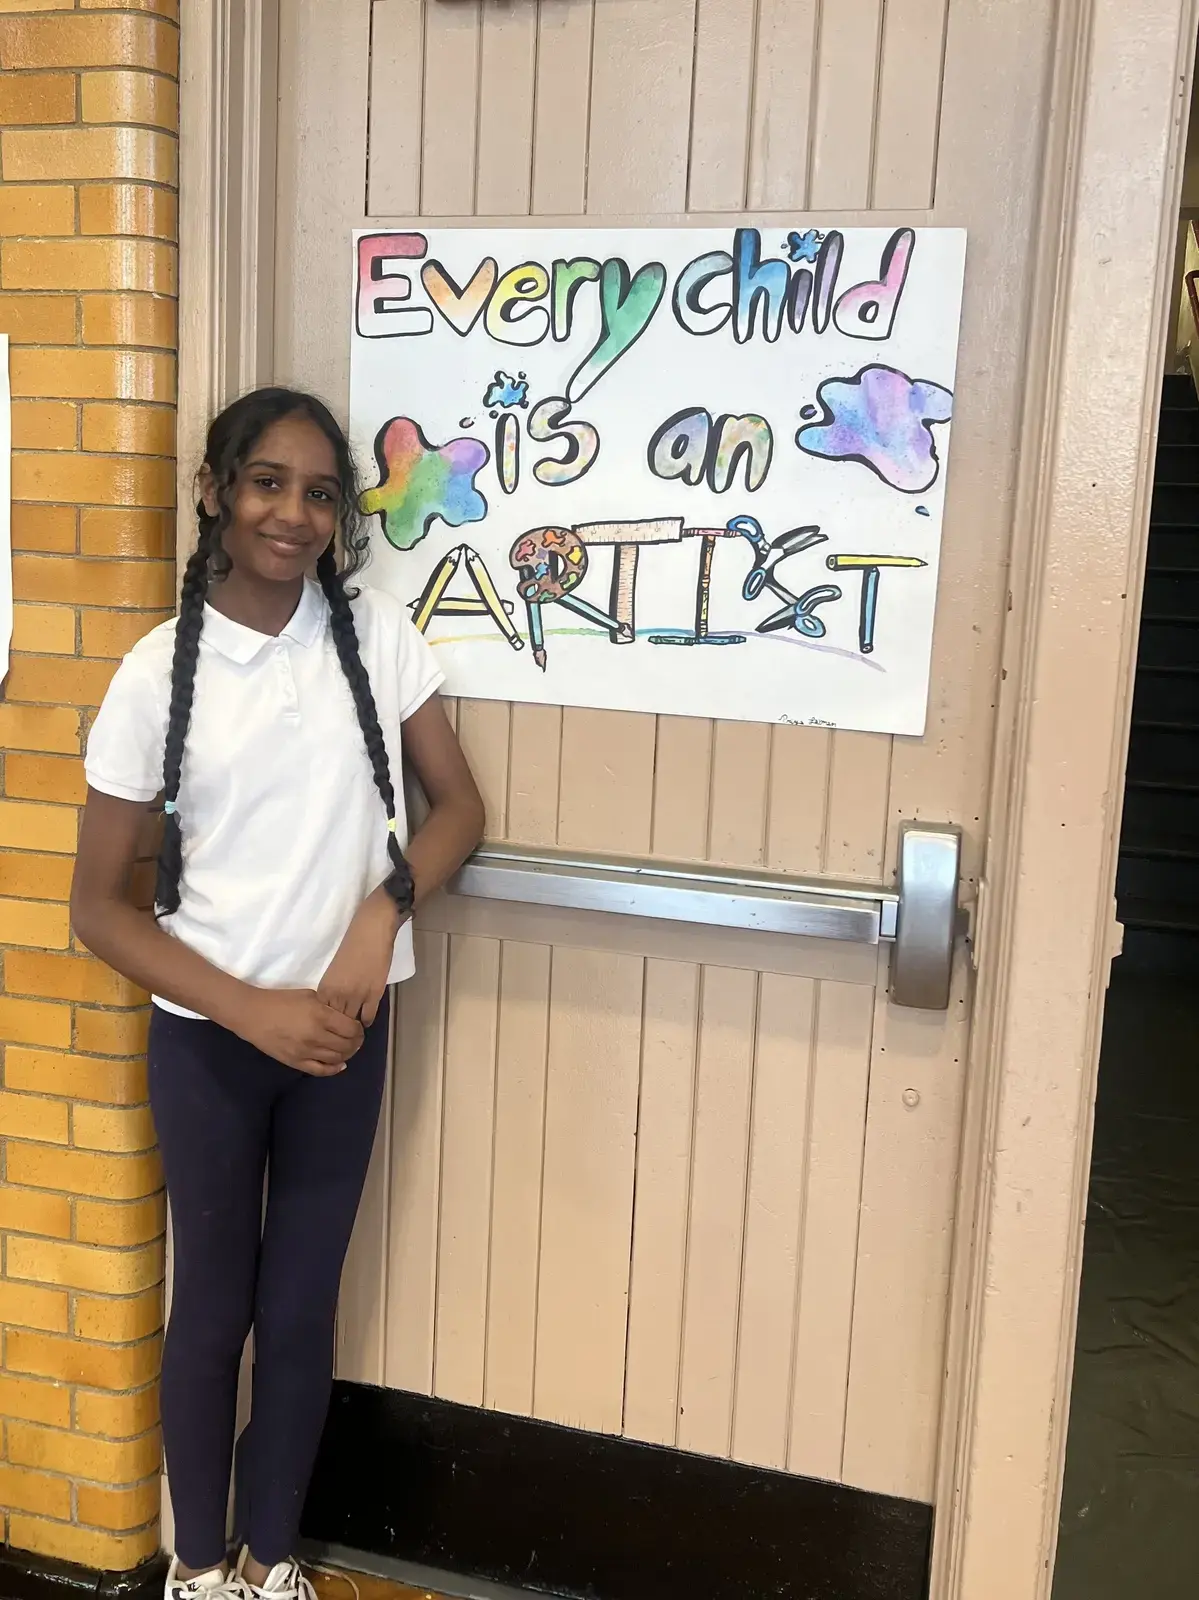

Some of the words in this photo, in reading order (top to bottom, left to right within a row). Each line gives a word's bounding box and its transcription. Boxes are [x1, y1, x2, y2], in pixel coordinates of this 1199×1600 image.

[356, 231, 667, 402] Every
[672, 228, 915, 343] child
[483, 371, 600, 494] is
[647, 406, 773, 493] an
[406, 514, 928, 672] ARTIST
